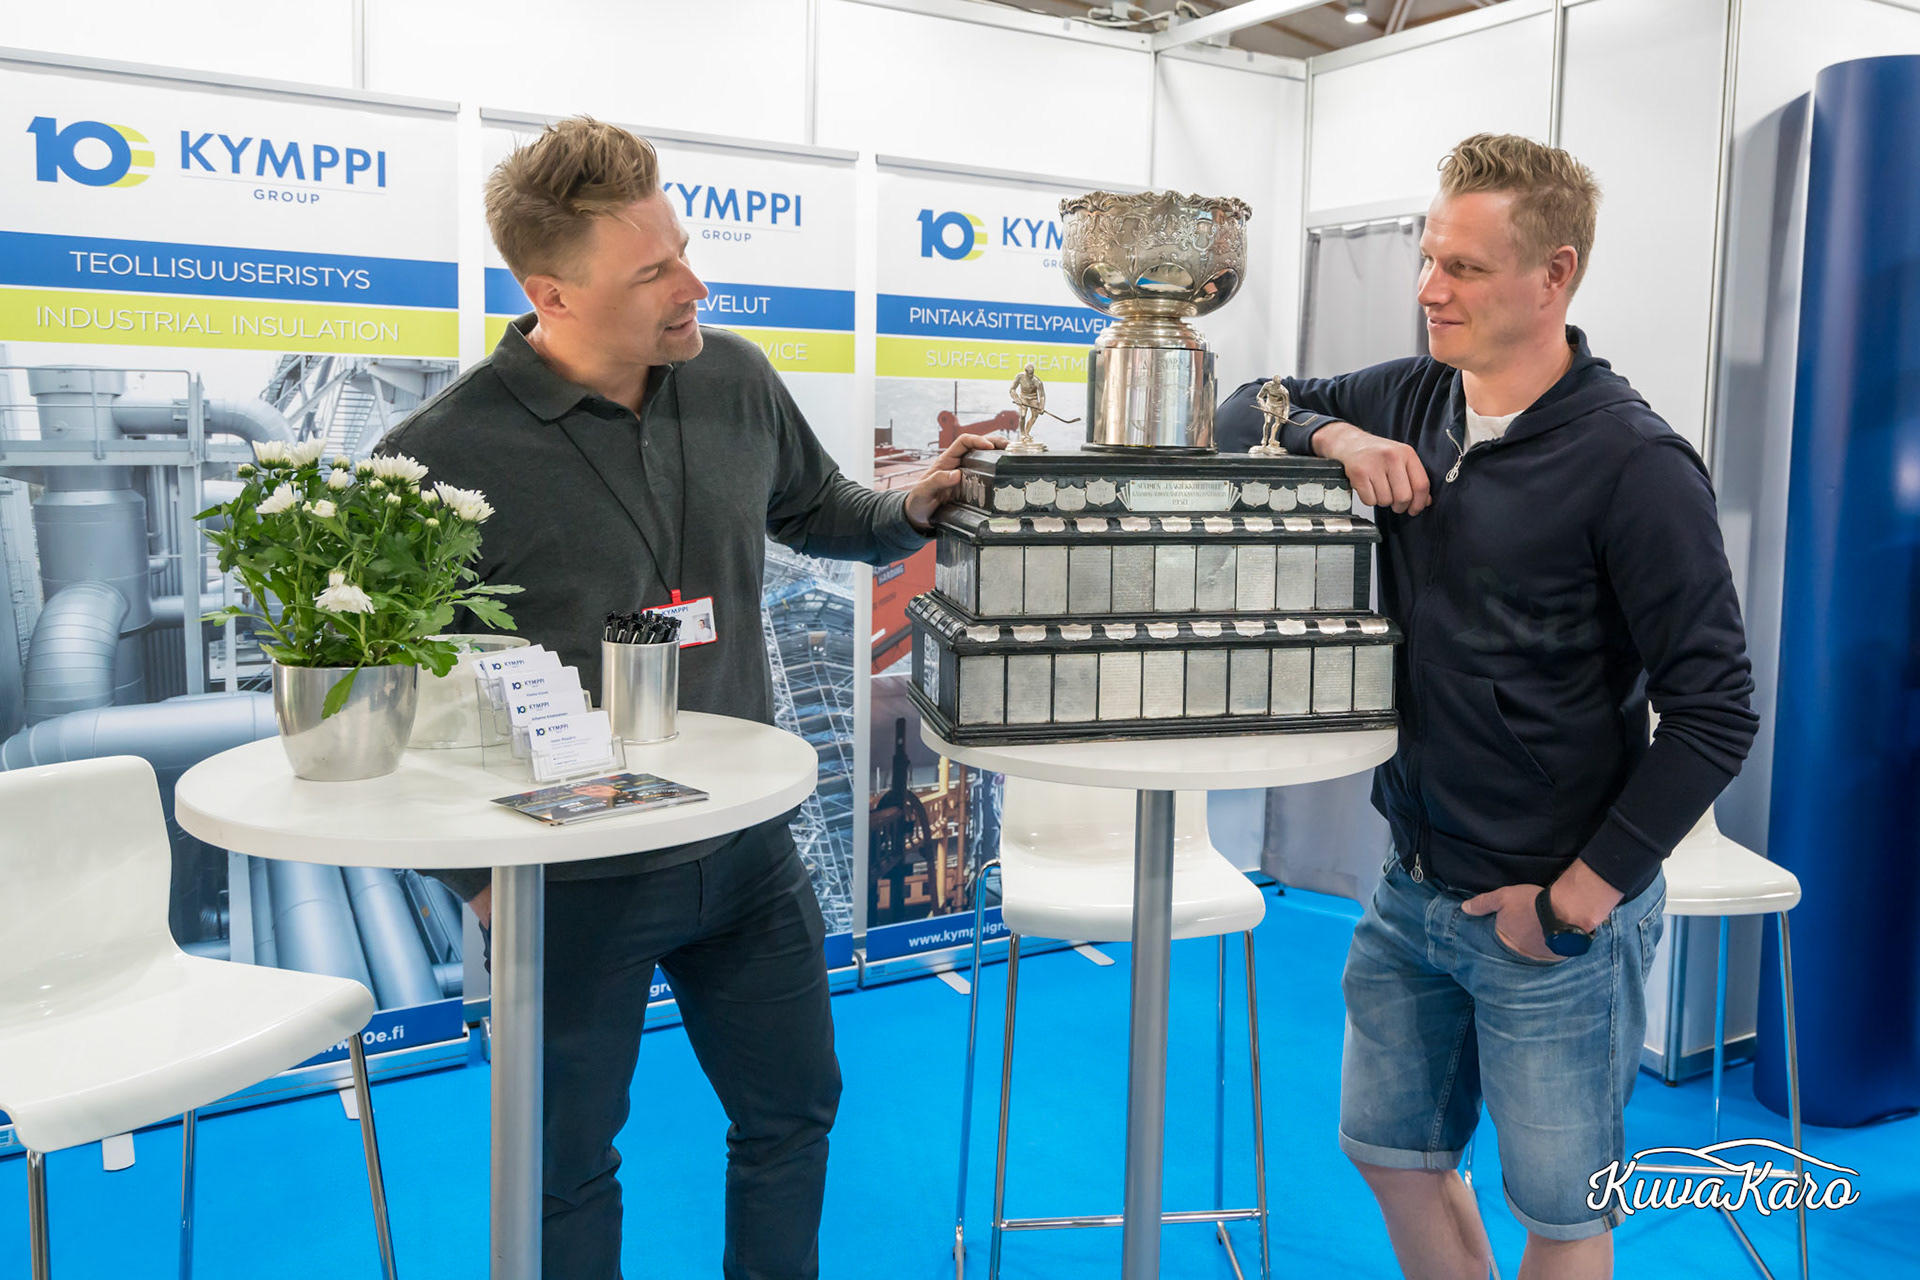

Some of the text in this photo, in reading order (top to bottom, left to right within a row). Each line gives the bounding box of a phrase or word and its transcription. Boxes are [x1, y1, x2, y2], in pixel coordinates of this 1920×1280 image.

[180, 130, 387, 187] KYMPPI
[253, 189, 320, 204] GROUP
[662, 182, 801, 226] YMPPI
[702, 229, 752, 242] GROUP
[1002, 216, 1063, 250] KYM
[69, 251, 371, 290] TEOLLISUUSERISTYS
[36, 305, 399, 342] INDUSTRIAL INSULATION
[760, 342, 808, 360] VICE
[926, 350, 1010, 369] SURFACE
[661, 606, 689, 616] KYMPPI
[504, 659, 525, 667] KYMPPI
[524, 678, 545, 686] KYMPPI
[529, 701, 550, 710] KYMPPI
[548, 723, 569, 732] KYMPPI
